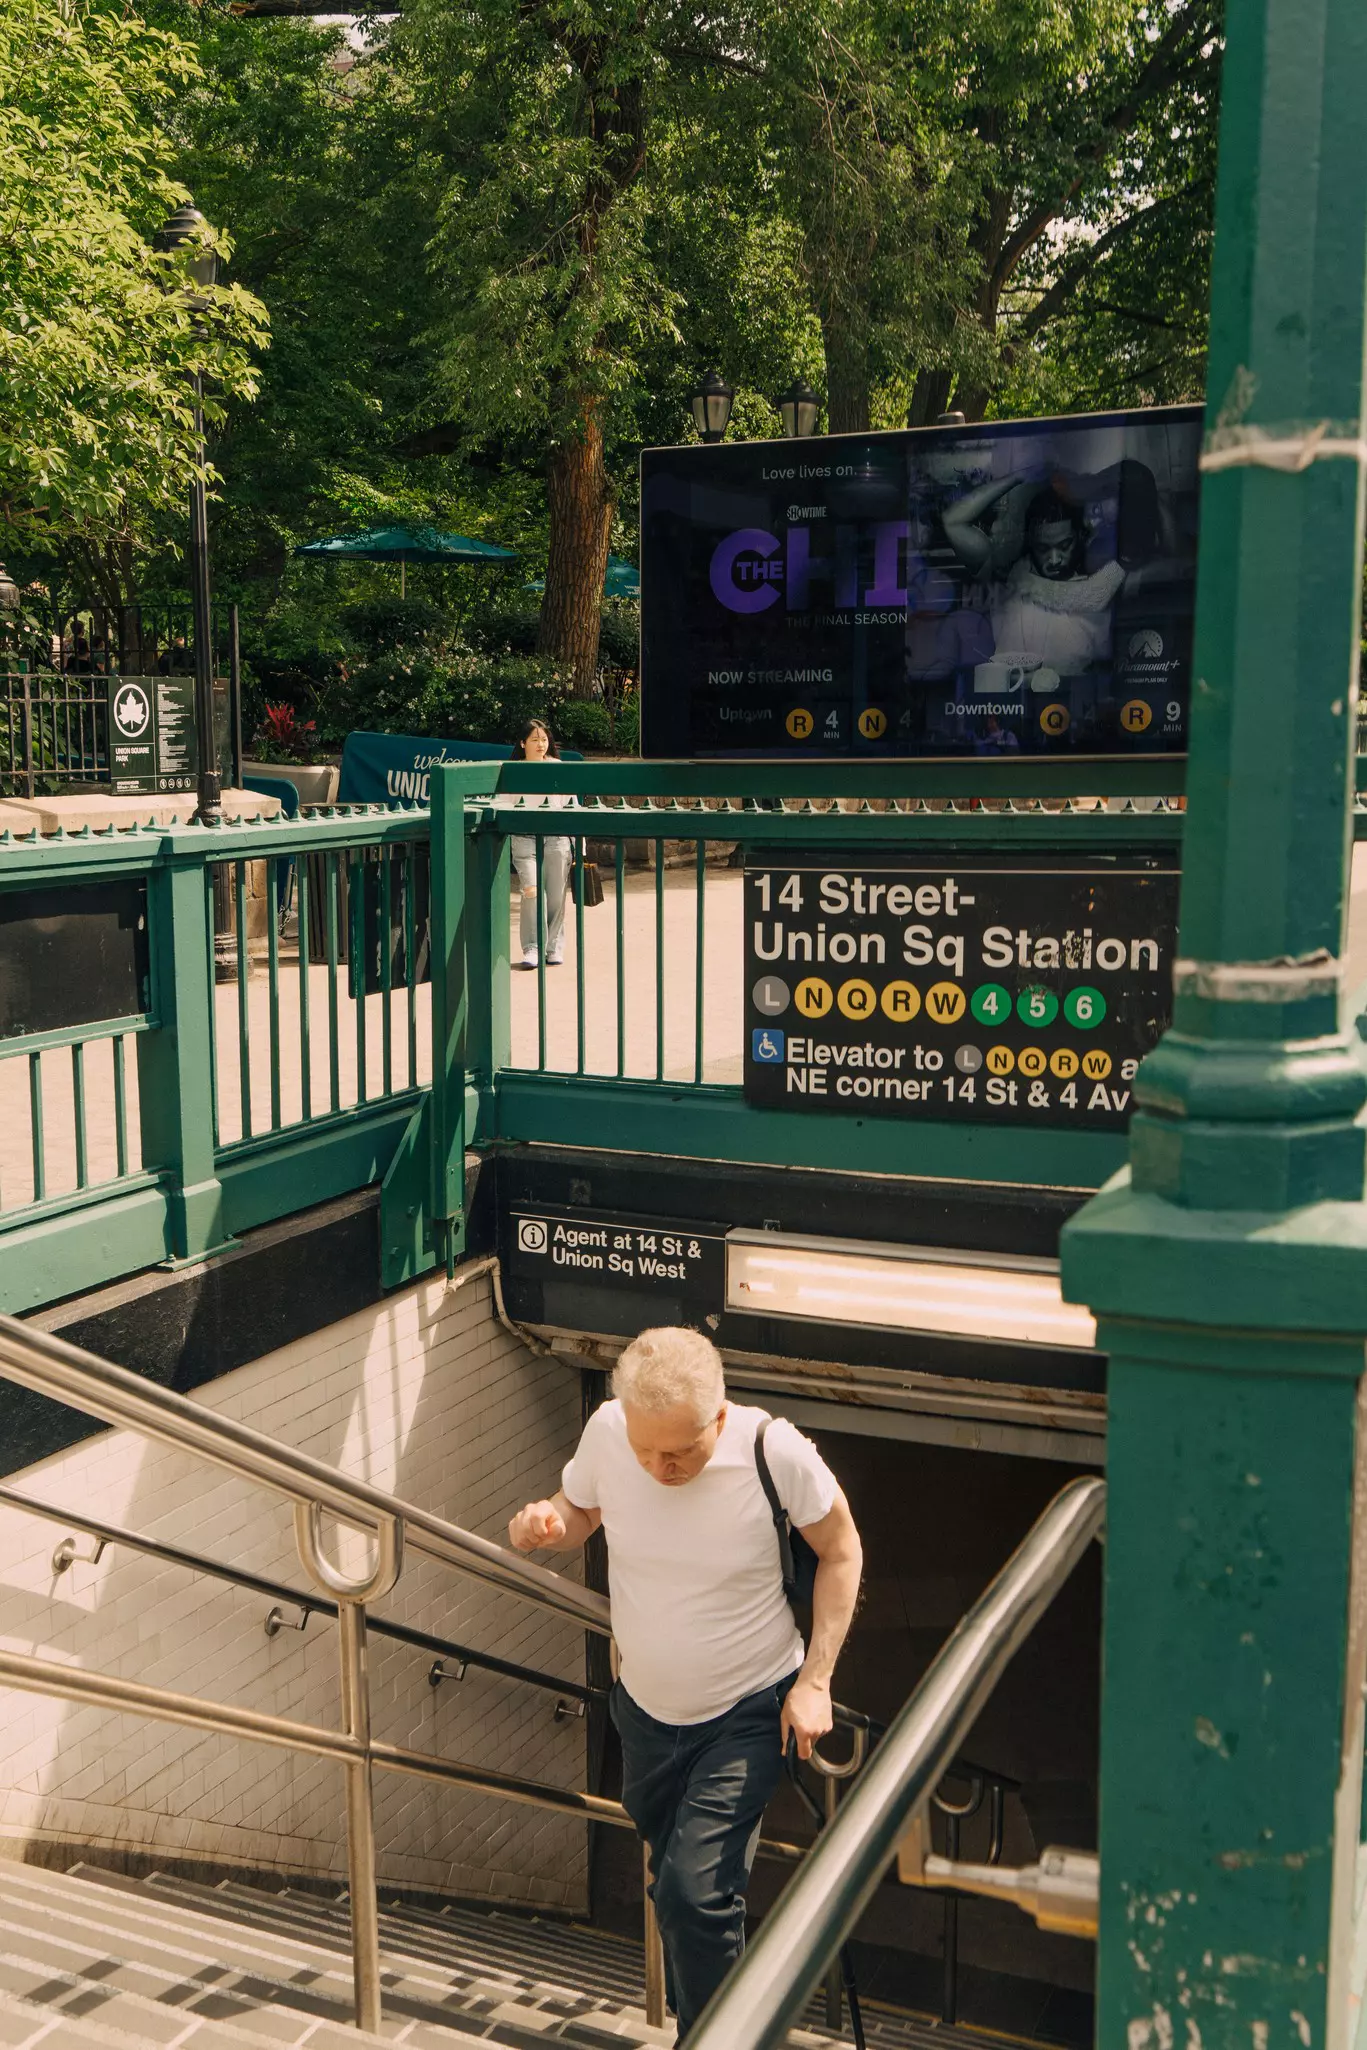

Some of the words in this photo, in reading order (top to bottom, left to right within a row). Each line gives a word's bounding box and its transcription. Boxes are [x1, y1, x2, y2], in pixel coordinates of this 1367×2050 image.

[762, 467, 795, 480] Love
[799, 465, 831, 479] lives
[835, 465, 857, 477] on.
[786, 505, 827, 521] SHOWTIME
[709, 520, 908, 614] CHI
[736, 560, 783, 580] THE
[854, 613, 908, 624] SEASON
[708, 671, 743, 685] NOW
[747, 668, 833, 684] STREAMING
[719, 707, 773, 723] Uptown
[793, 716, 806, 732] R
[825, 709, 839, 729] 4
[866, 715, 880, 732] N
[944, 702, 1024, 715] Downtown
[1047, 711, 1063, 729] Q
[1129, 707, 1143, 725] R
[1165, 701, 1181, 722] 9
[1163, 724, 1182, 732] MIN
[823, 731, 840, 739] MIN
[753, 873, 804, 913] 14
[819, 875, 975, 917] Street-
[753, 921, 885, 963] Union
[903, 925, 965, 977] Sq
[982, 926, 1159, 972] Station
[765, 984, 780, 1006] L
[805, 987, 823, 1010] N
[847, 988, 868, 1011] Q
[892, 990, 911, 1012] R
[932, 992, 959, 1016] W
[982, 991, 999, 1016] 4
[1029, 994, 1046, 1018] 5
[1076, 995, 1093, 1019] 6
[787, 1037, 905, 1069] Elevator
[913, 1045, 944, 1071] to
[963, 1050, 975, 1068] L
[994, 1053, 1007, 1069] N
[1025, 1054, 1040, 1071] Q
[1058, 1055, 1072, 1071] R
[1088, 1058, 1107, 1074] W
[1120, 1055, 1147, 1080] a
[786, 1067, 828, 1094] NE
[836, 1075, 933, 1101] corner
[942, 1075, 977, 1103] 14
[985, 1077, 1018, 1106] St
[1027, 1080, 1050, 1108] &
[1059, 1082, 1079, 1109] 4
[1087, 1083, 1130, 1112] Av
[553, 1224, 607, 1248] Agent
[613, 1233, 632, 1250] at
[636, 1234, 657, 1253] 14
[662, 1237, 683, 1256] St
[687, 1240, 702, 1259] &
[552, 1247, 603, 1269] Union
[608, 1253, 634, 1277] Sq
[638, 1257, 686, 1279] West
